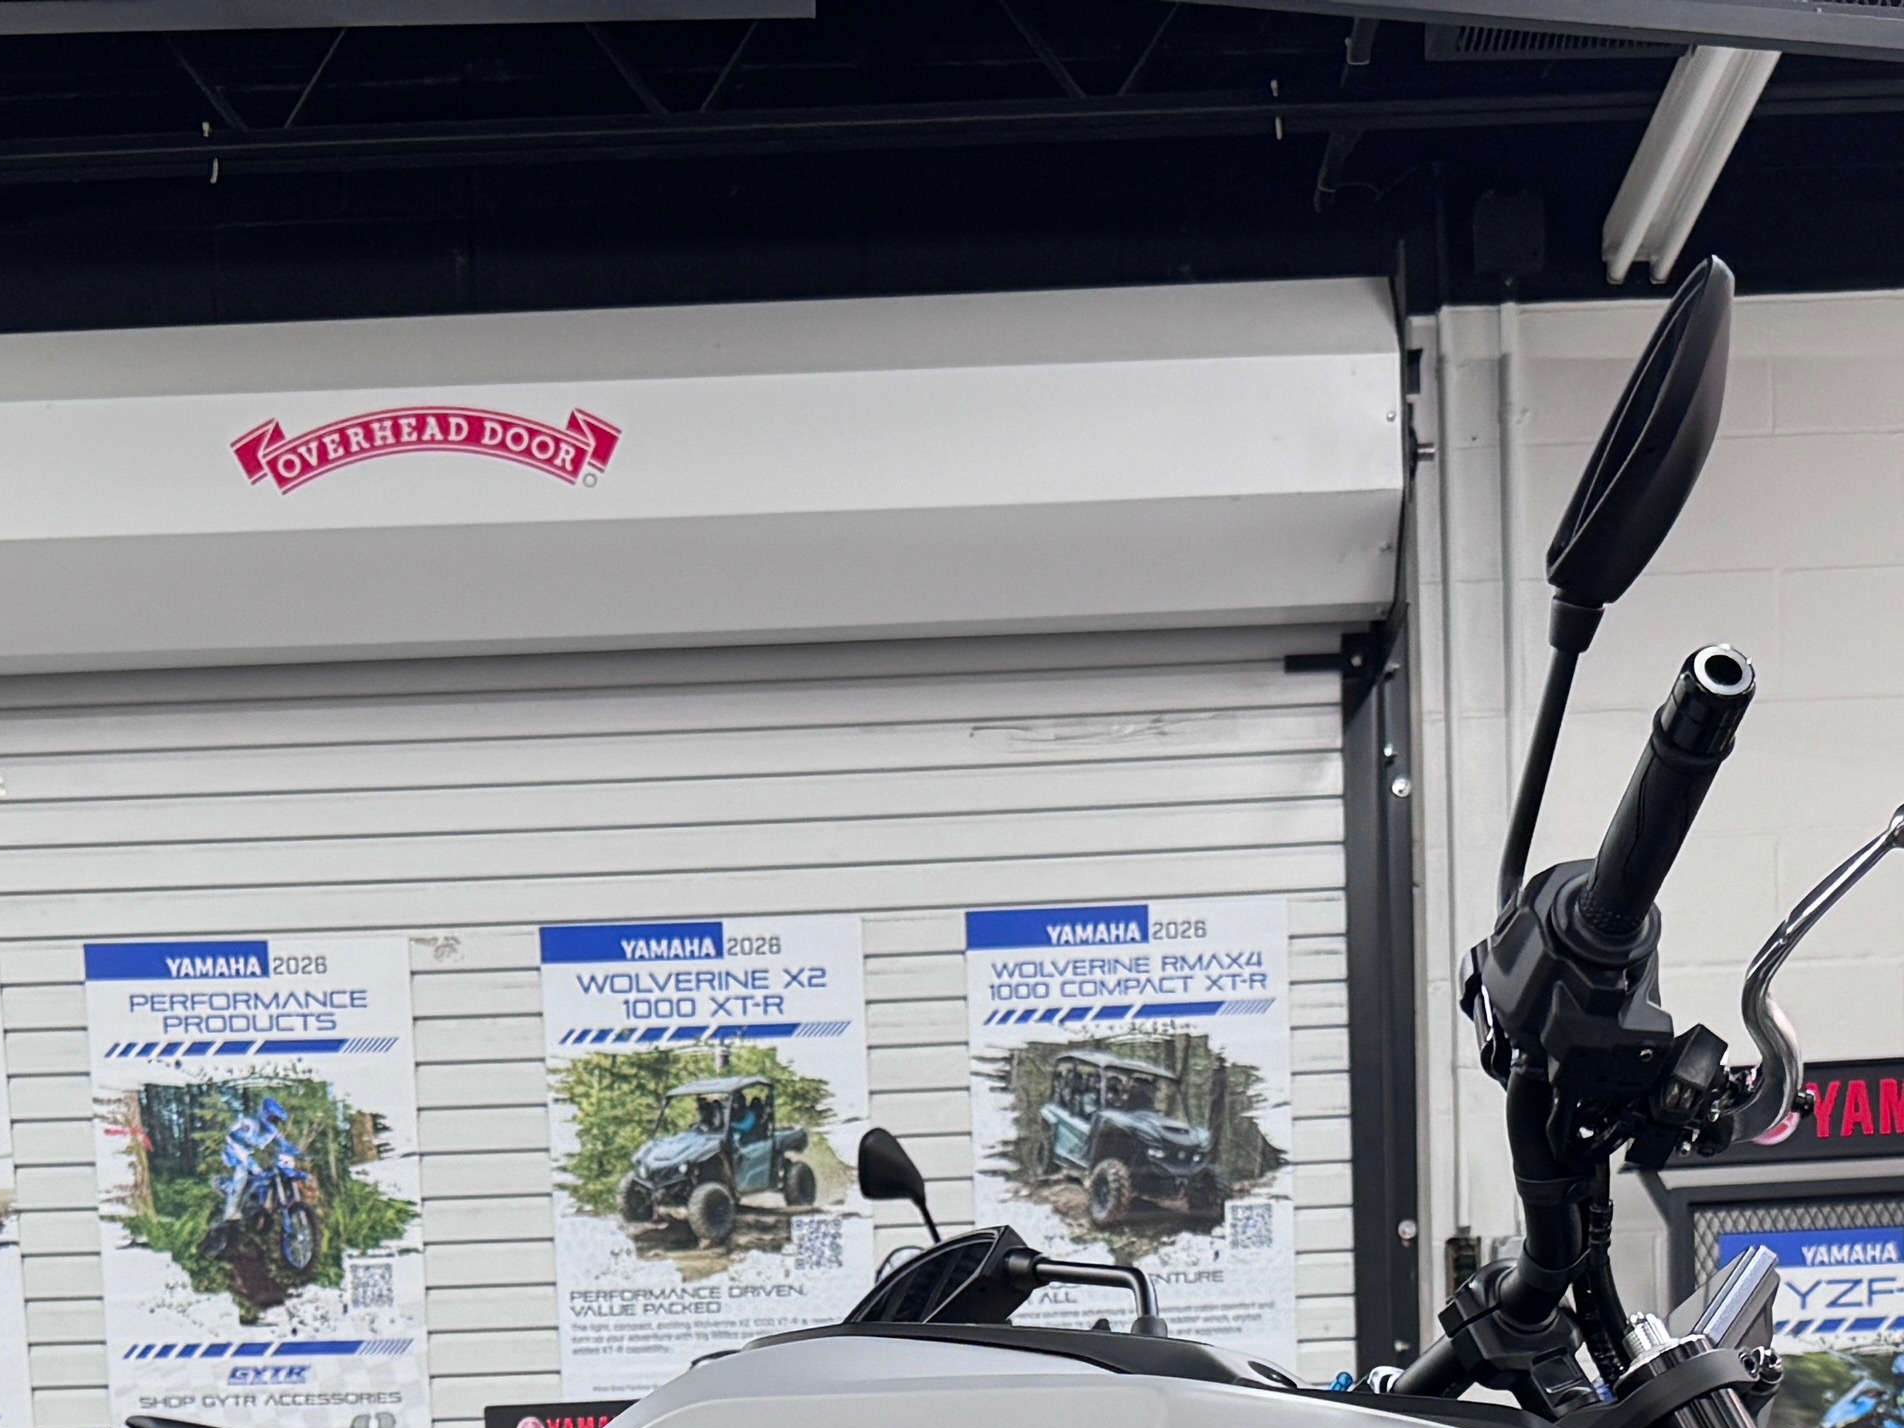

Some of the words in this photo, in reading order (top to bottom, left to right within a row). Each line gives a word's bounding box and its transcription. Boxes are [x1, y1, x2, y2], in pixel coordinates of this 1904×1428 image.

[277, 417, 469, 479] OVERHEAD
[484, 425, 575, 471] DOOR
[1046, 921, 1142, 946] YAMAHA
[1152, 920, 1207, 941] 2026
[621, 937, 716, 961] YAMAHA
[727, 936, 782, 957] 2026
[166, 956, 262, 978] YAMAHA
[273, 956, 328, 975] 2026
[991, 955, 1150, 980] WOLVERINE
[1161, 951, 1262, 973] RMAX4
[576, 969, 770, 995] WOLVERINE
[783, 967, 828, 990] X2
[989, 982, 1050, 1002] 1000
[1060, 976, 1194, 999] COMPACT
[1205, 972, 1268, 992] XT-R
[129, 990, 368, 1013] PERFORMANCE
[623, 997, 696, 1020] 1000
[710, 994, 785, 1018] XT-R
[162, 1012, 337, 1035] PRODUCTS
[1801, 1242, 1897, 1266] YAMAHA
[569, 1285, 722, 1303] PERFORMANCE
[569, 1302, 636, 1318] VALUE
[643, 1300, 722, 1316] PACKED
[228, 1364, 311, 1382] GYTR
[139, 1395, 195, 1409] SHOP
[202, 1394, 257, 1408] GYTR
[264, 1391, 403, 1407] ACCESSORIES
